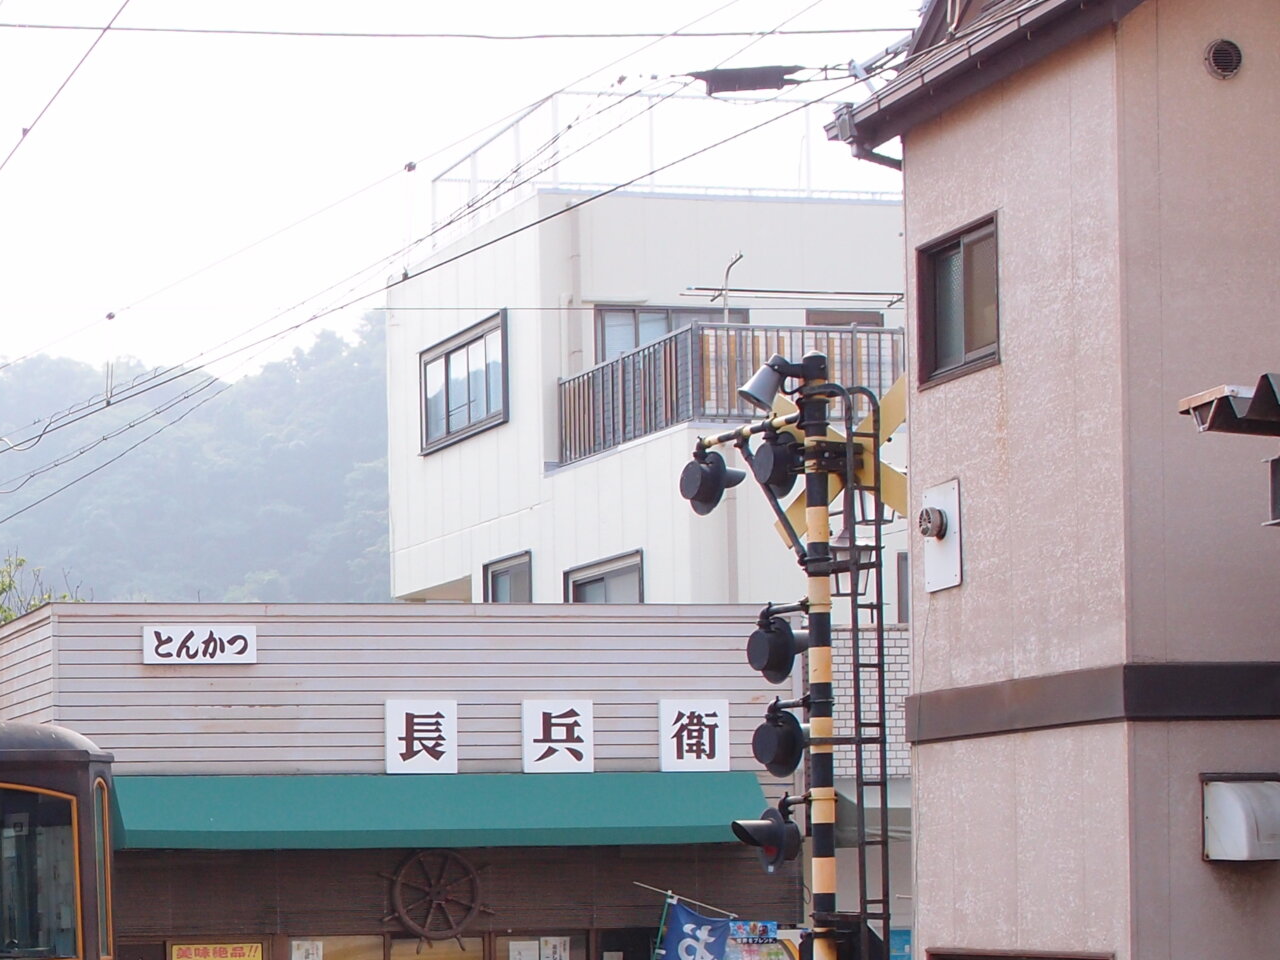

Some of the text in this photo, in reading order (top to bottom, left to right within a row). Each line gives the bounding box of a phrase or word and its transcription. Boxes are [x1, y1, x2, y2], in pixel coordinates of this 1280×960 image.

[153, 629, 249, 660] とんかつ
[397, 708, 720, 763] 長兵衛
